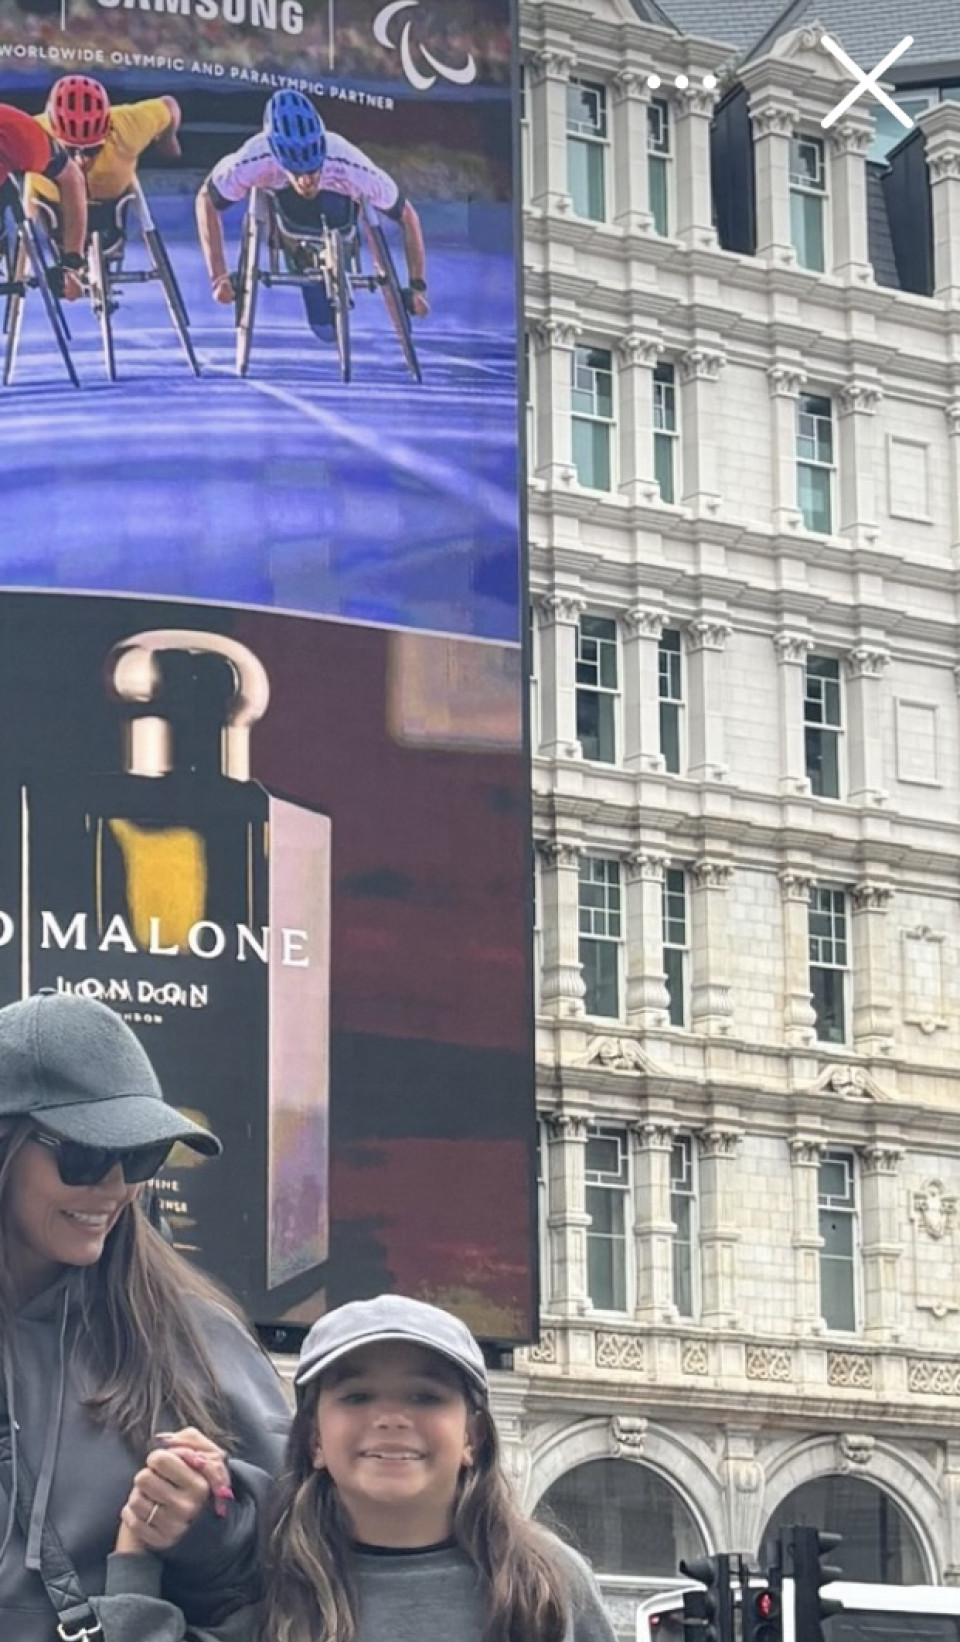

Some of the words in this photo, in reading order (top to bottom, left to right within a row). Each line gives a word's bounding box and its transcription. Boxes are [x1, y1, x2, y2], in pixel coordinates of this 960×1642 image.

[111, 52, 185, 73] OLYMPIC
[191, 61, 224, 77] AND
[230, 66, 325, 97] PARALYMPIC
[329, 84, 394, 111] PARTNER
[41, 911, 310, 968] MALONE
